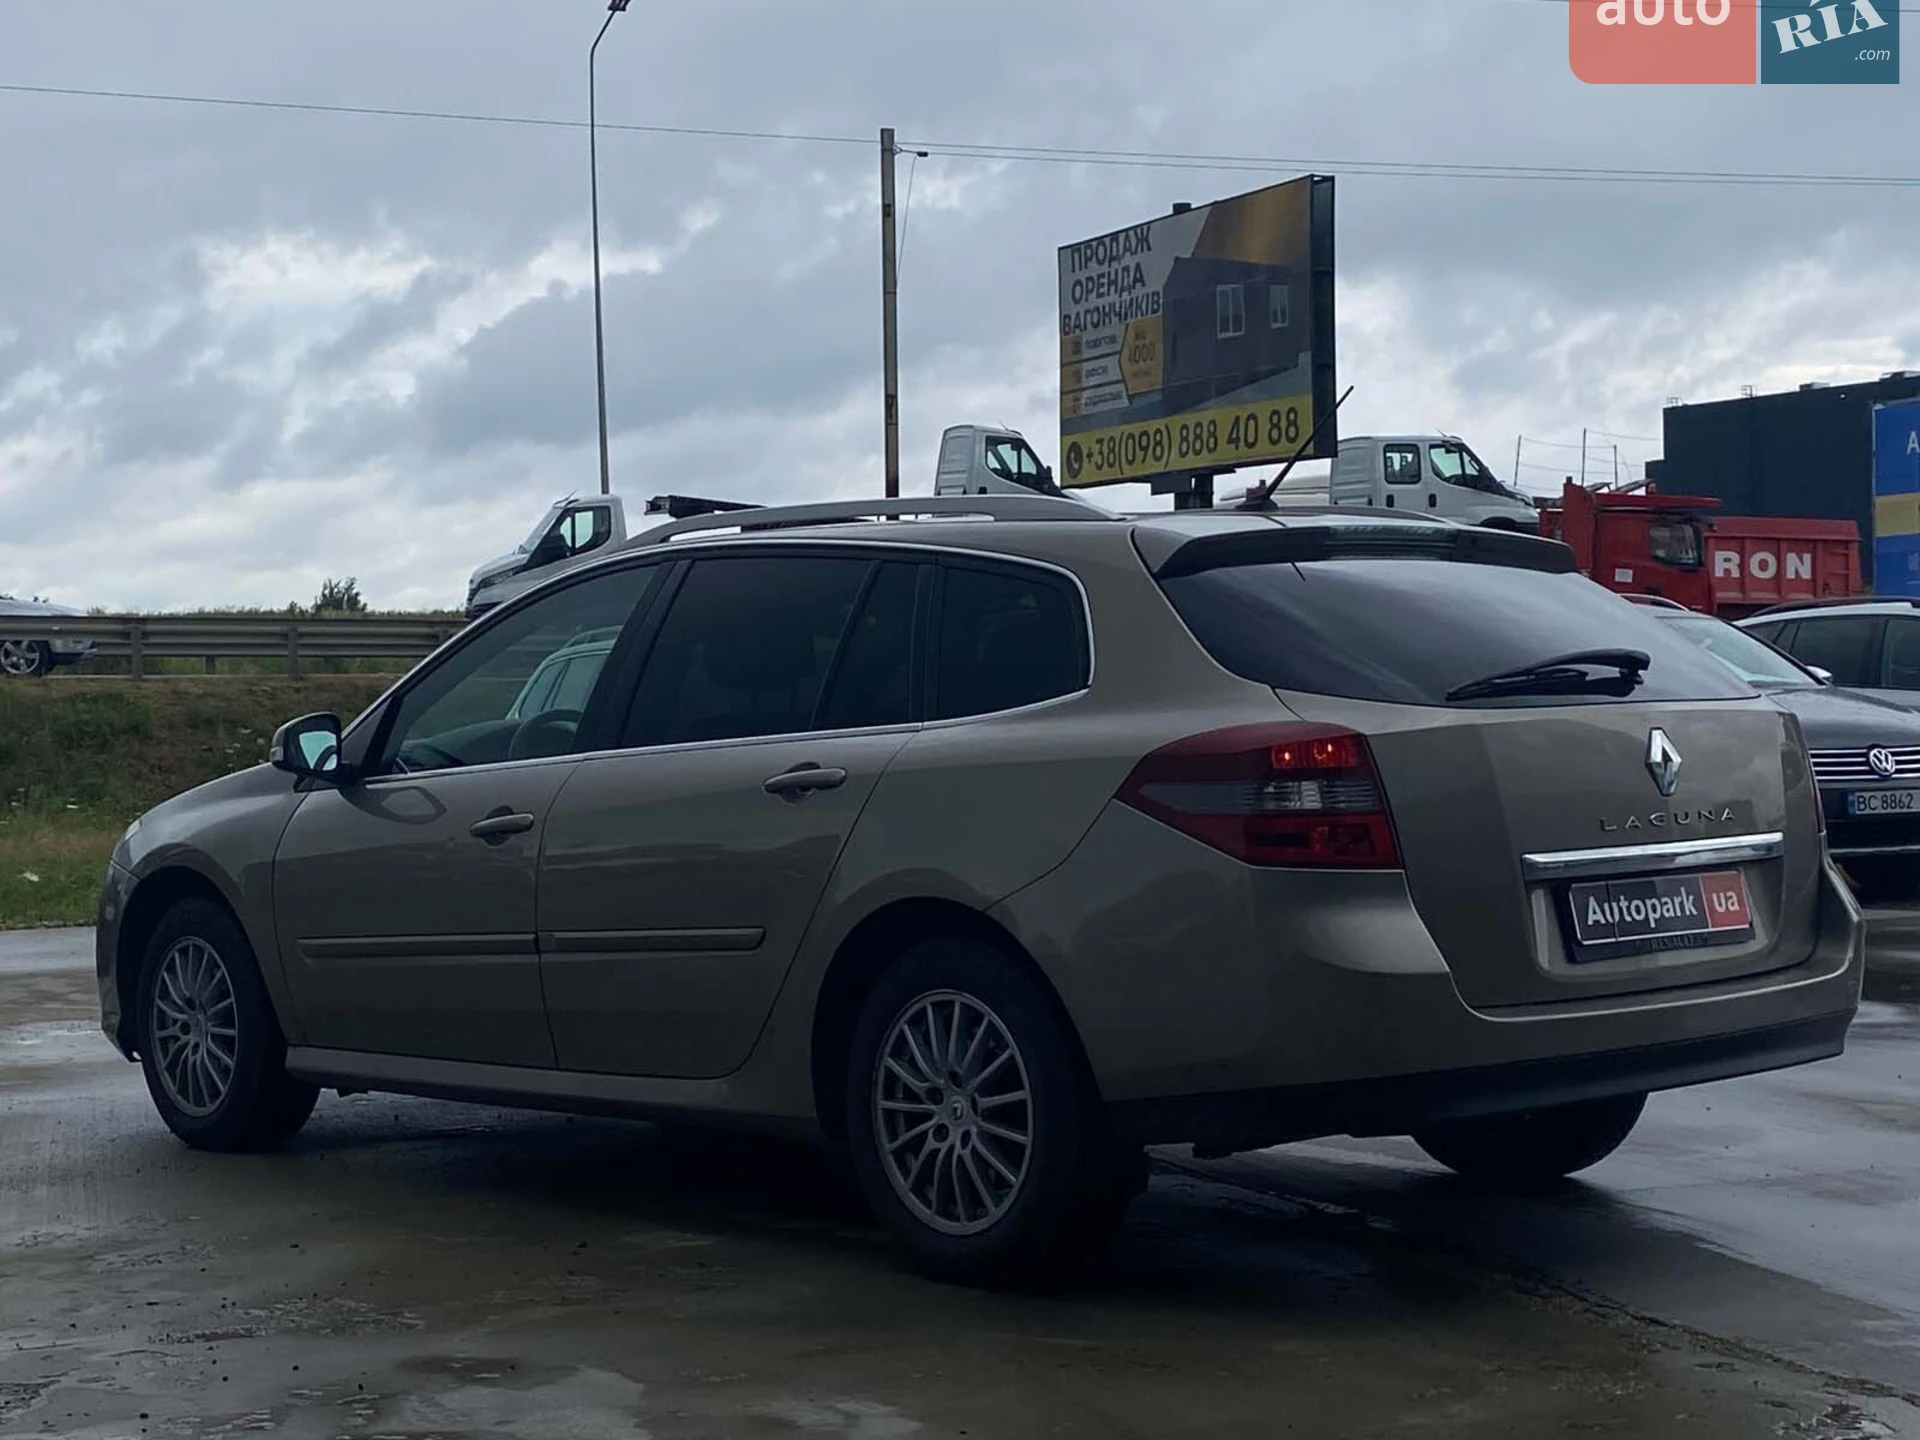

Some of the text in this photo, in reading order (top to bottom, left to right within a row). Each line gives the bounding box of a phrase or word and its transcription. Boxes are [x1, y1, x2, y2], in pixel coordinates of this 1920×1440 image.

[1070, 225, 1152, 273] ПРОДАЖ
[1071, 262, 1146, 305] ОРЕНДА
[1063, 291, 1161, 336] ВАГОНЧИКІВ
[1085, 406, 1299, 476] +38(098) 888 40 88
[1714, 551, 1812, 580] RON
[1601, 807, 1736, 832] LAGUNA
[1587, 886, 1740, 928] Autopark ua
